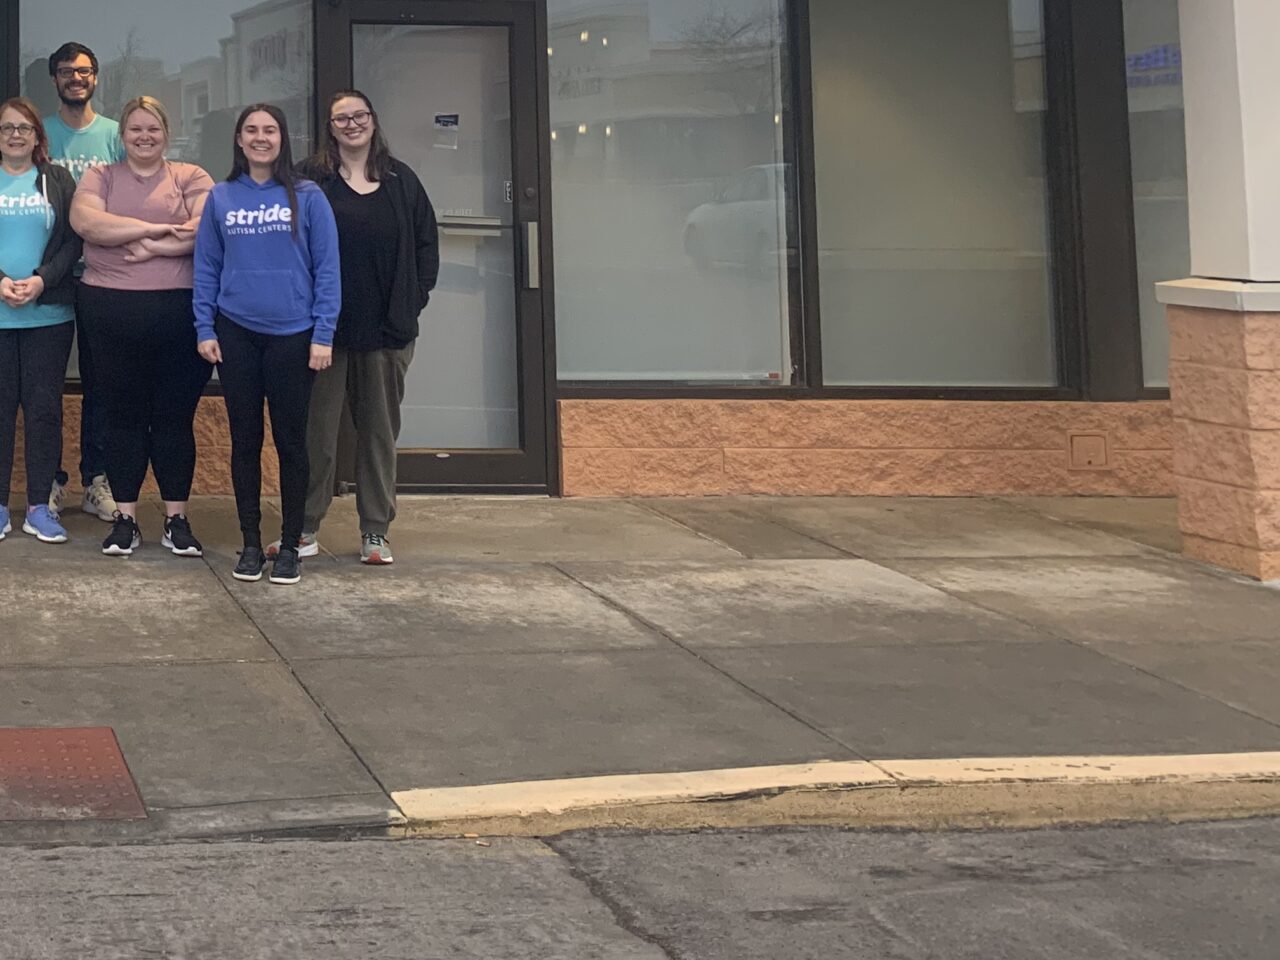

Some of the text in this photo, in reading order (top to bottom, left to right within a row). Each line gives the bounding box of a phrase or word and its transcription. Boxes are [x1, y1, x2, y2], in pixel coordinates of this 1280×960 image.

[225, 203, 292, 226] stride
[227, 224, 292, 235] AUTISM CENTERS
